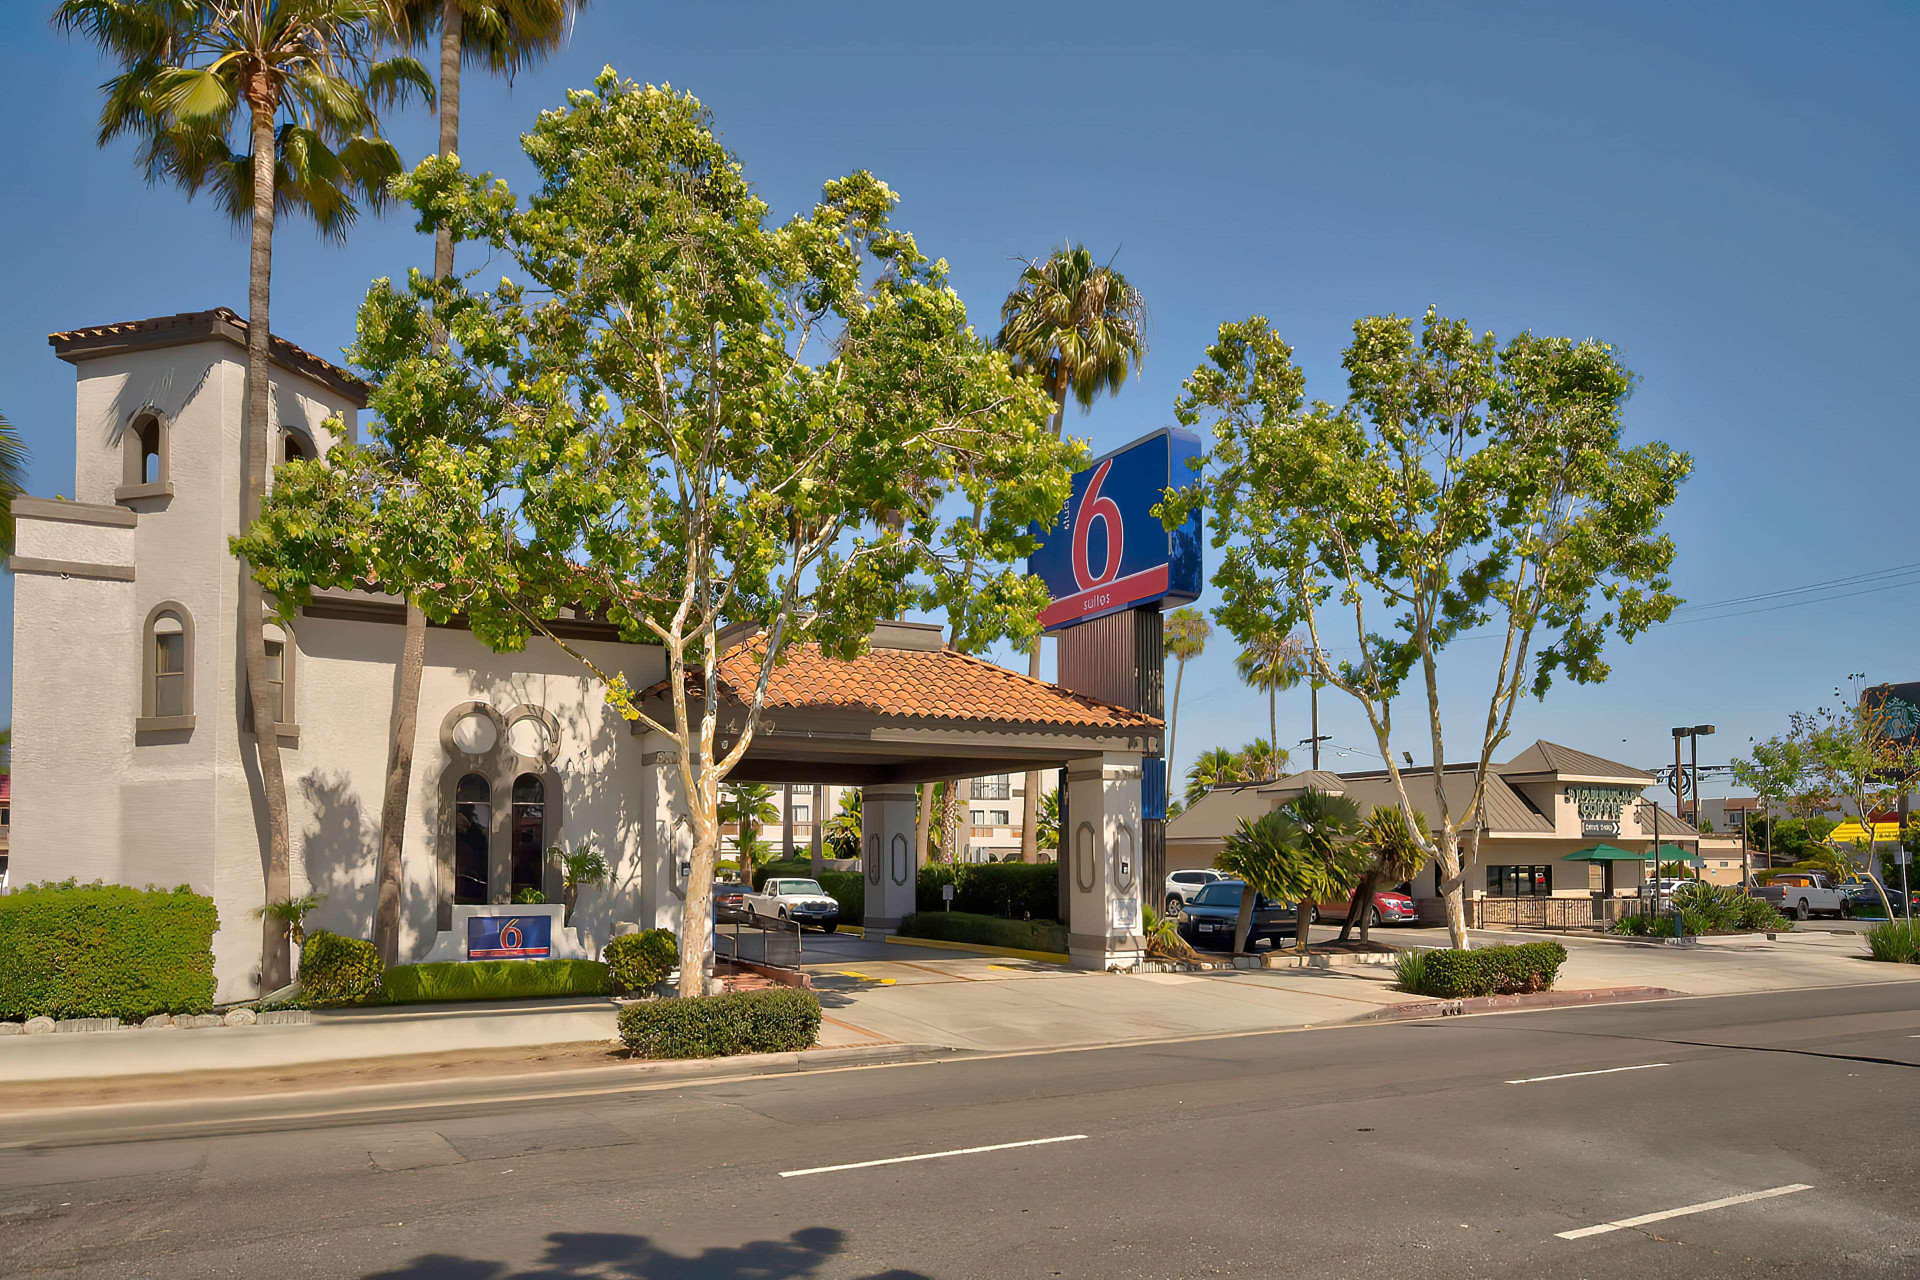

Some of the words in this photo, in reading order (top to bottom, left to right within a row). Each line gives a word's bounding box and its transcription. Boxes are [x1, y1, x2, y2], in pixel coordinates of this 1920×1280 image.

[1072, 458, 1124, 593] 6
[1567, 787, 1637, 803] STARBUCKS
[1580, 802, 1623, 815] COFFEE
[500, 918, 523, 950] 6
